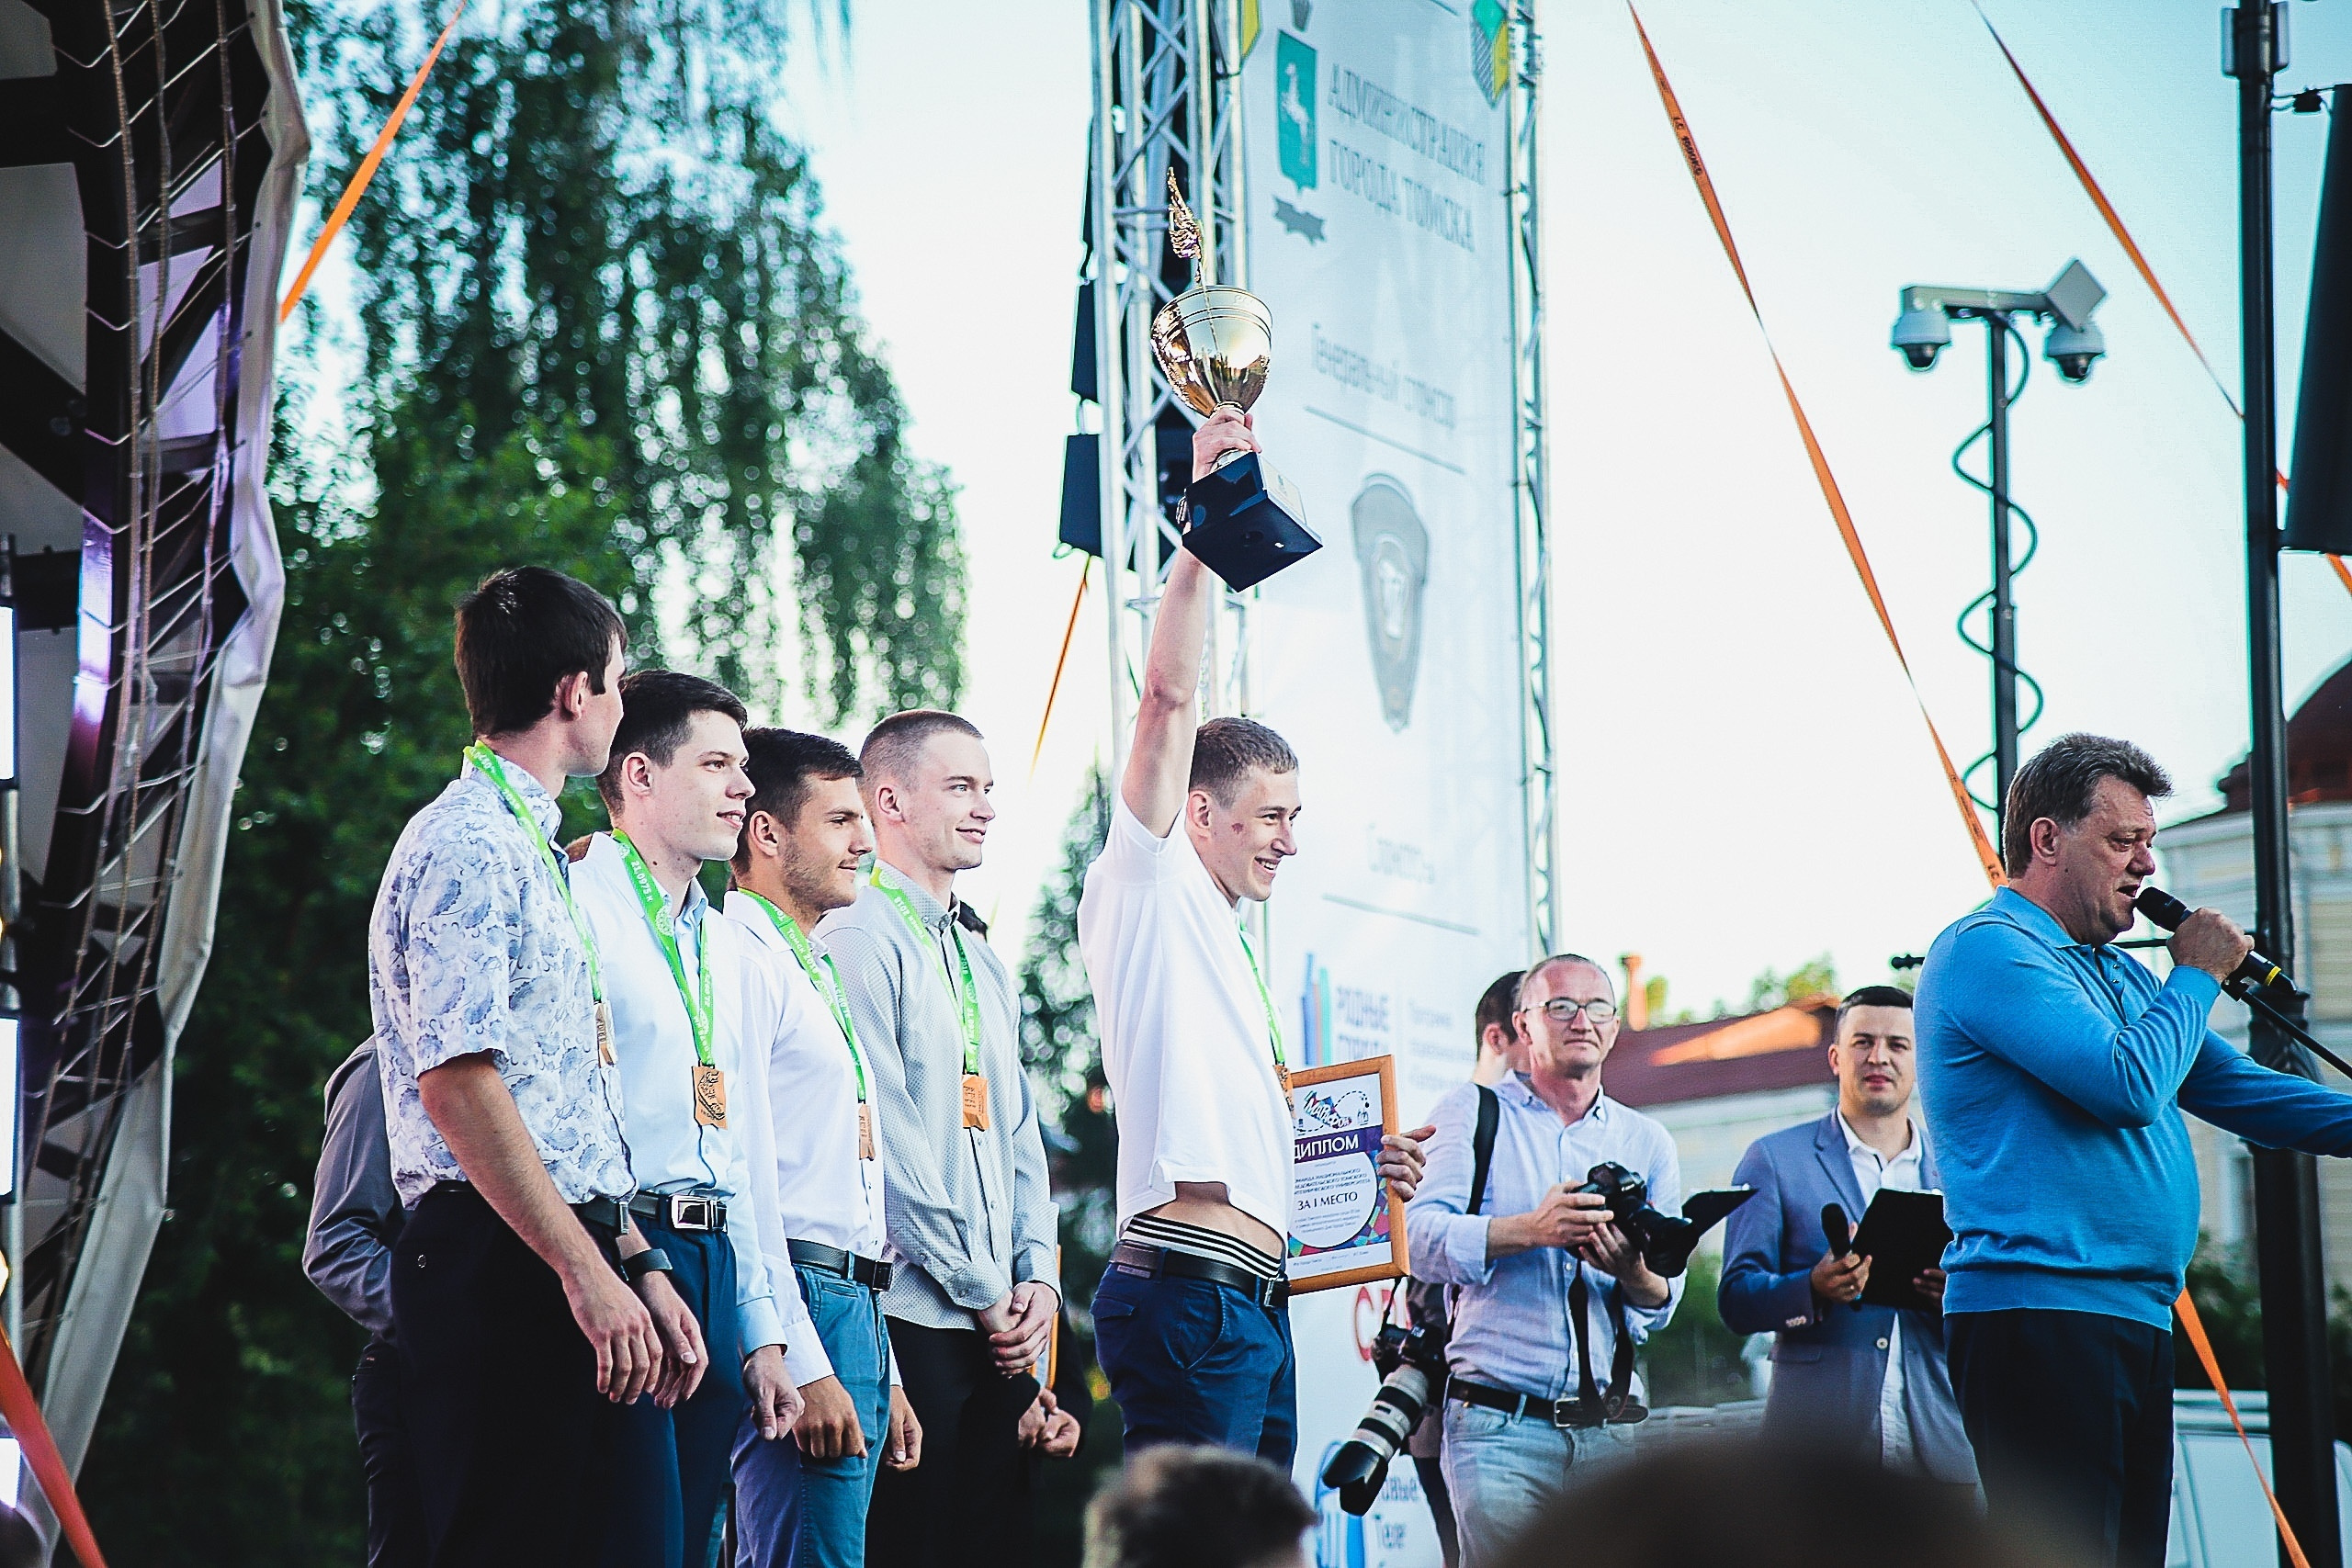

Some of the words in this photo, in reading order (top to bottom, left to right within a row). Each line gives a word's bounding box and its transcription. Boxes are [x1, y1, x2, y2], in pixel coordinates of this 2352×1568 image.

[1329, 139, 1401, 217] ГОРОДА
[1402, 175, 1475, 252] ТОМСКА
[893, 895, 910, 917] 2018
[785, 926, 807, 954] Томск
[1295, 1134, 1359, 1160] ДИПЛОМ
[1297, 1200, 1311, 1211] ЗА
[1320, 1190, 1358, 1207] МЕСТО
